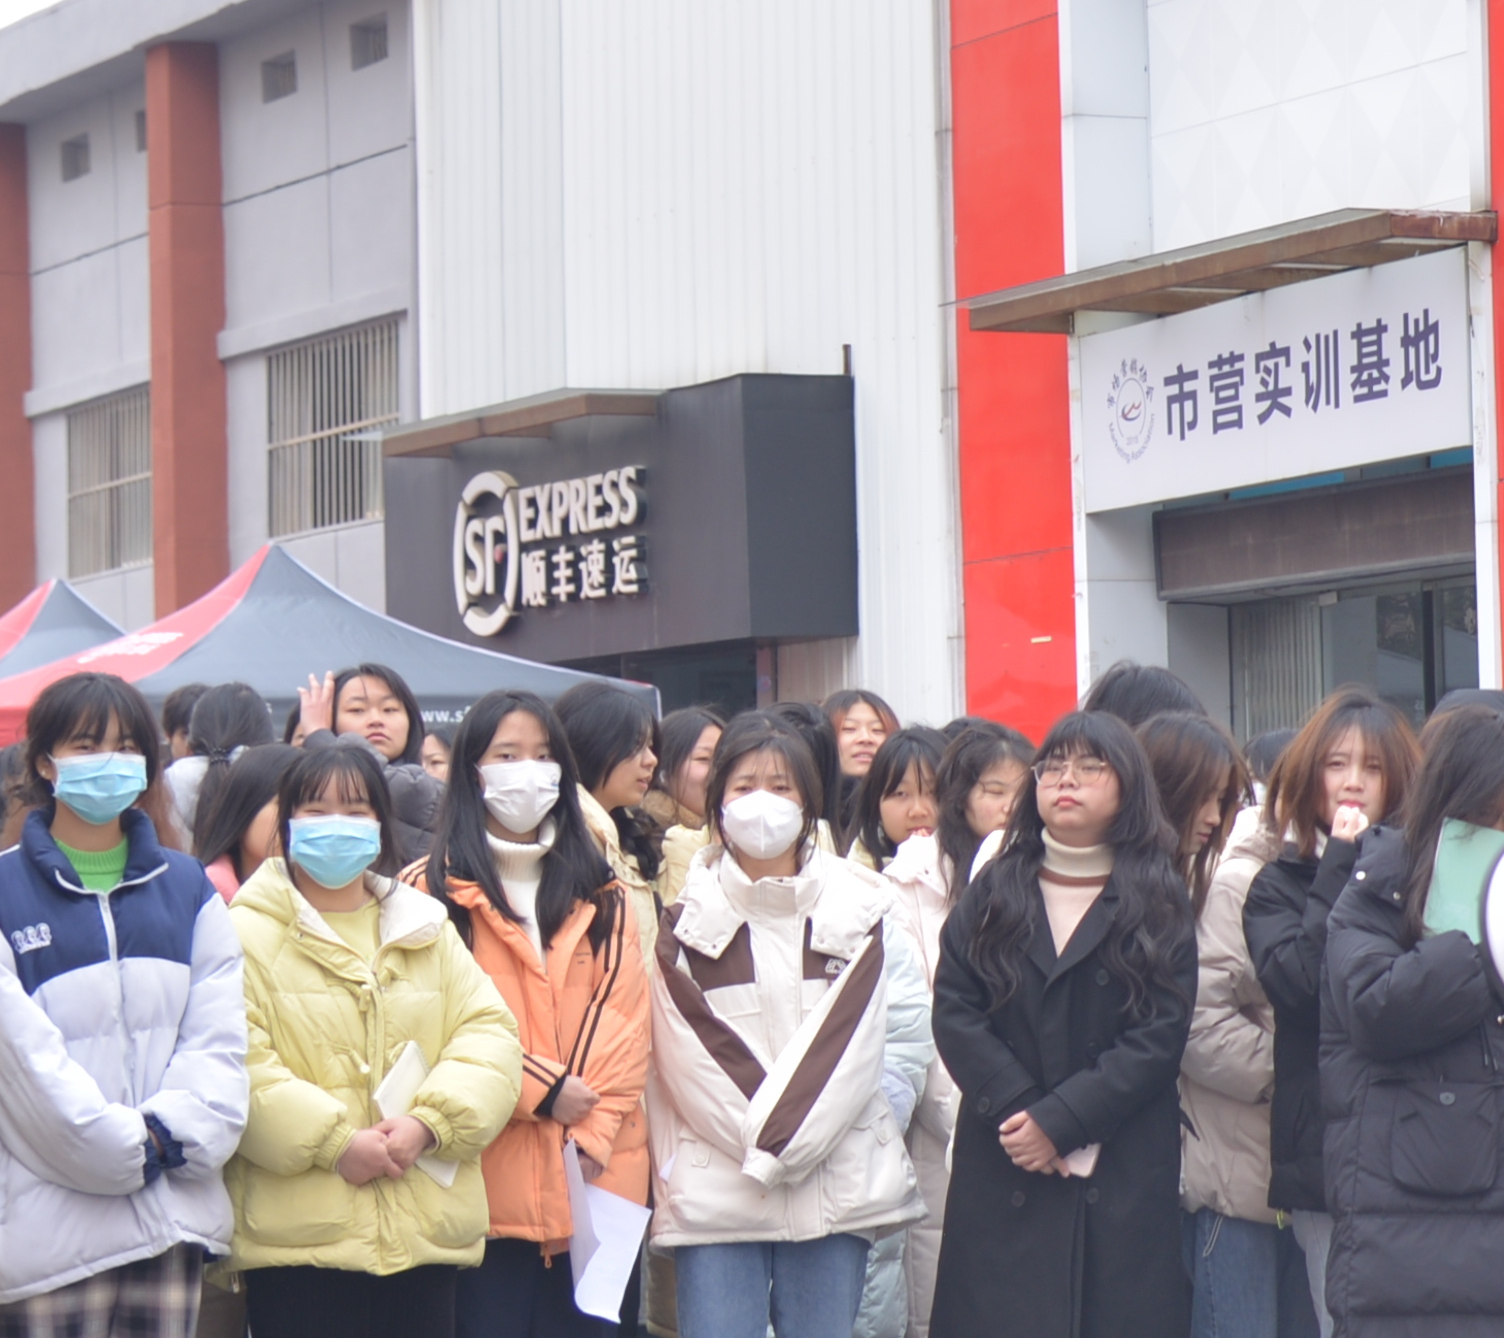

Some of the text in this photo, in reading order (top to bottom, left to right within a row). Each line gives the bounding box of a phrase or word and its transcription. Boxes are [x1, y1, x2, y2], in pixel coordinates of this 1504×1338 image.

[1163, 308, 1443, 441] 市营实训基地
[518, 466, 639, 543] EXPRESS
[521, 535, 640, 607] 顺丰速运
